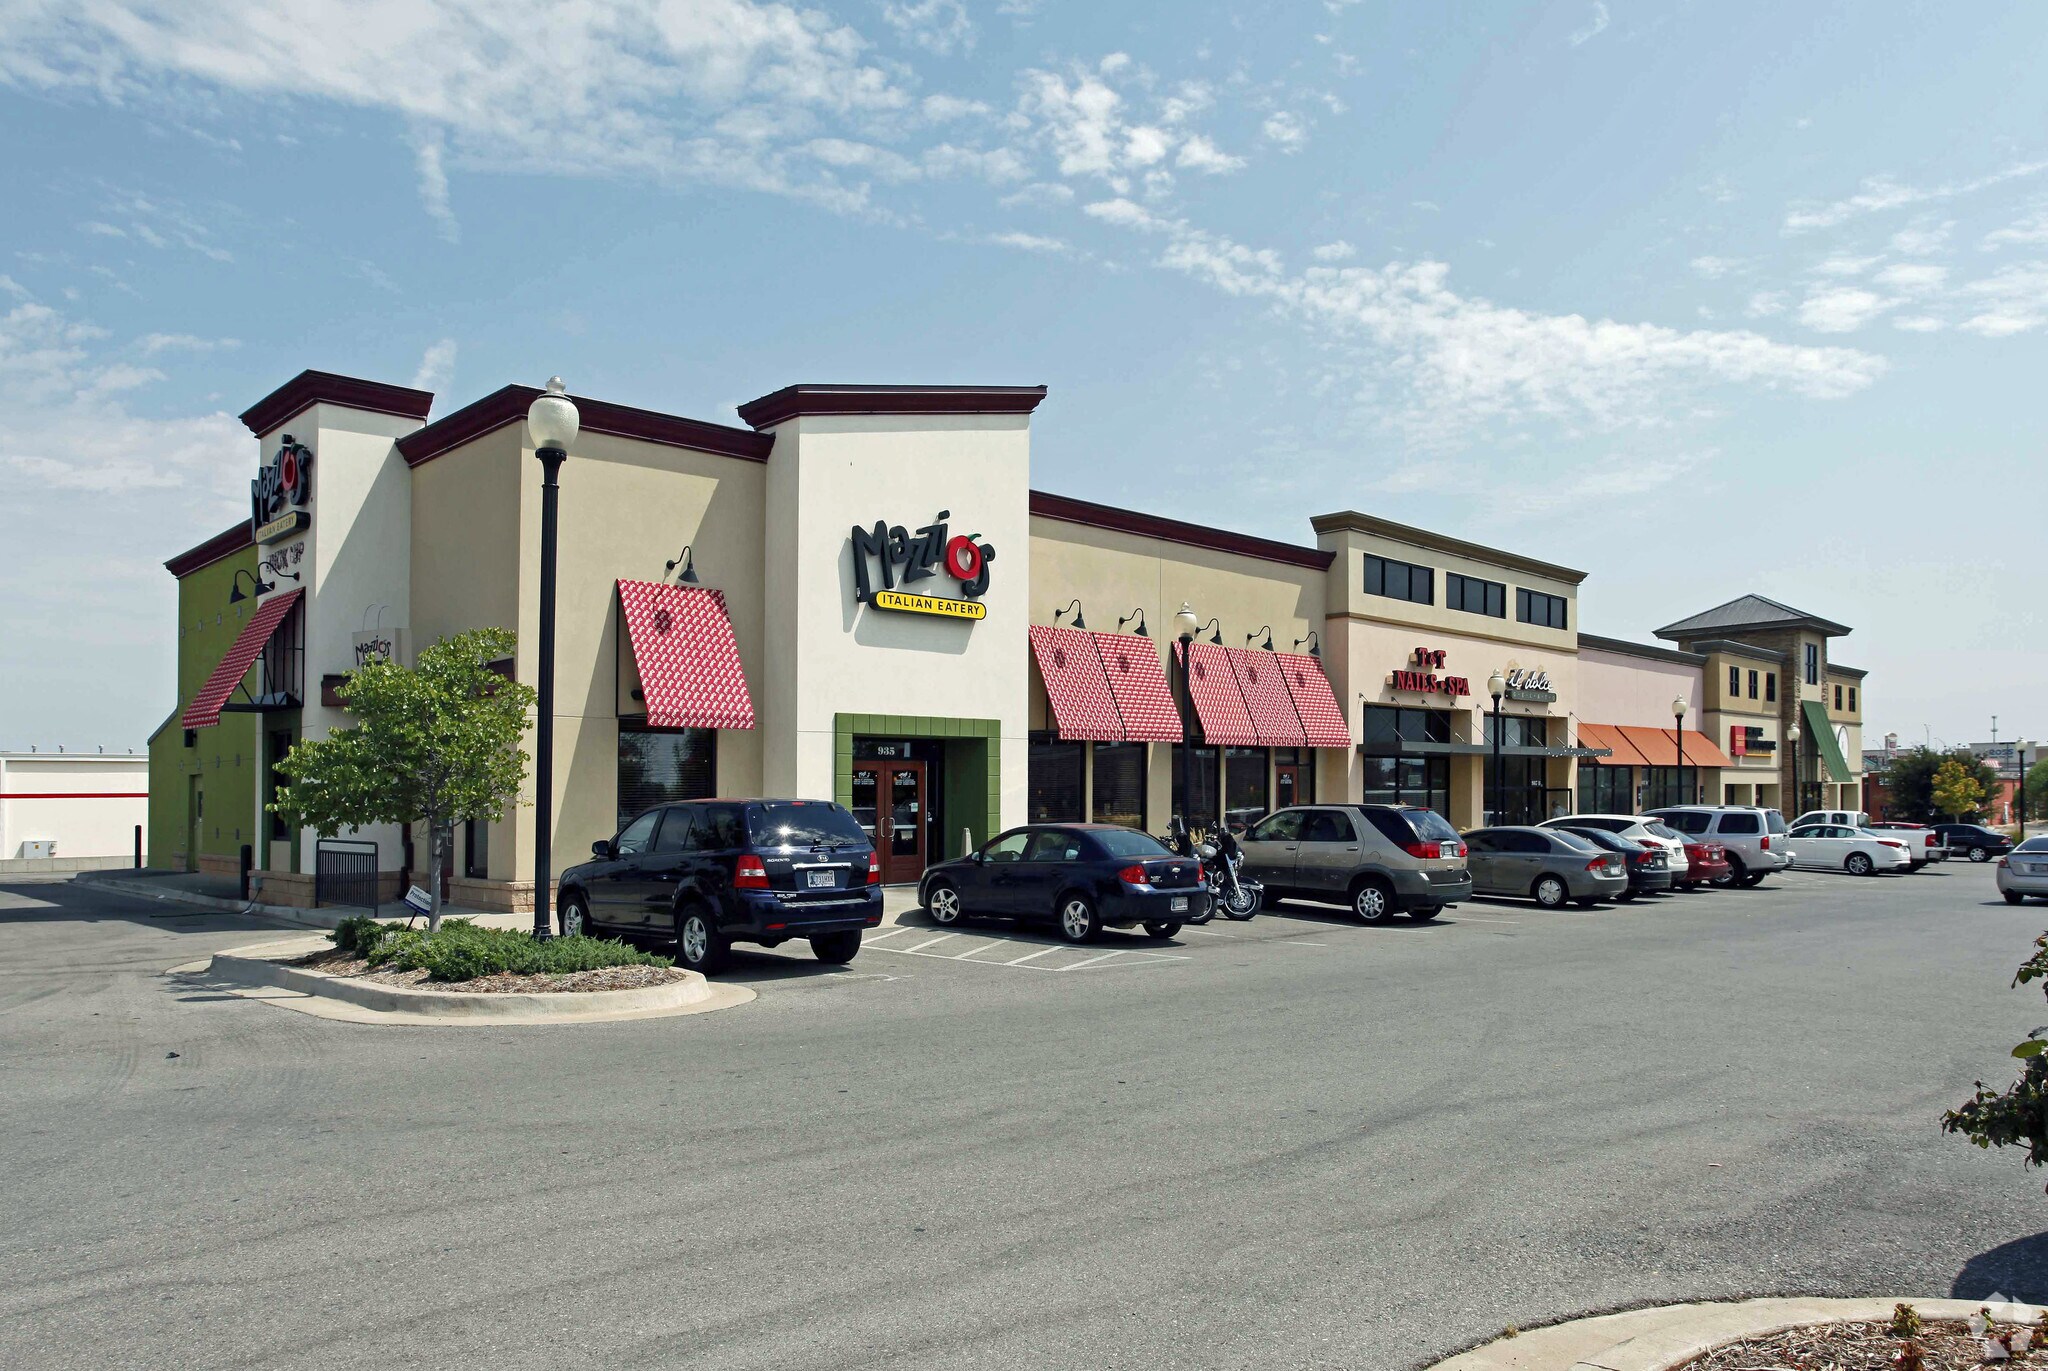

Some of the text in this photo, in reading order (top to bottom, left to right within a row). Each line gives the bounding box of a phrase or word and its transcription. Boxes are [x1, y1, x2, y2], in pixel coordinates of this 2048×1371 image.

[275, 515, 295, 533] EATERY
[882, 594, 980, 615] ITALIAN EATERY
[1393, 670, 1470, 696] NAILS SPA
[1522, 671, 1554, 690] dolce
[877, 746, 895, 755] 935
